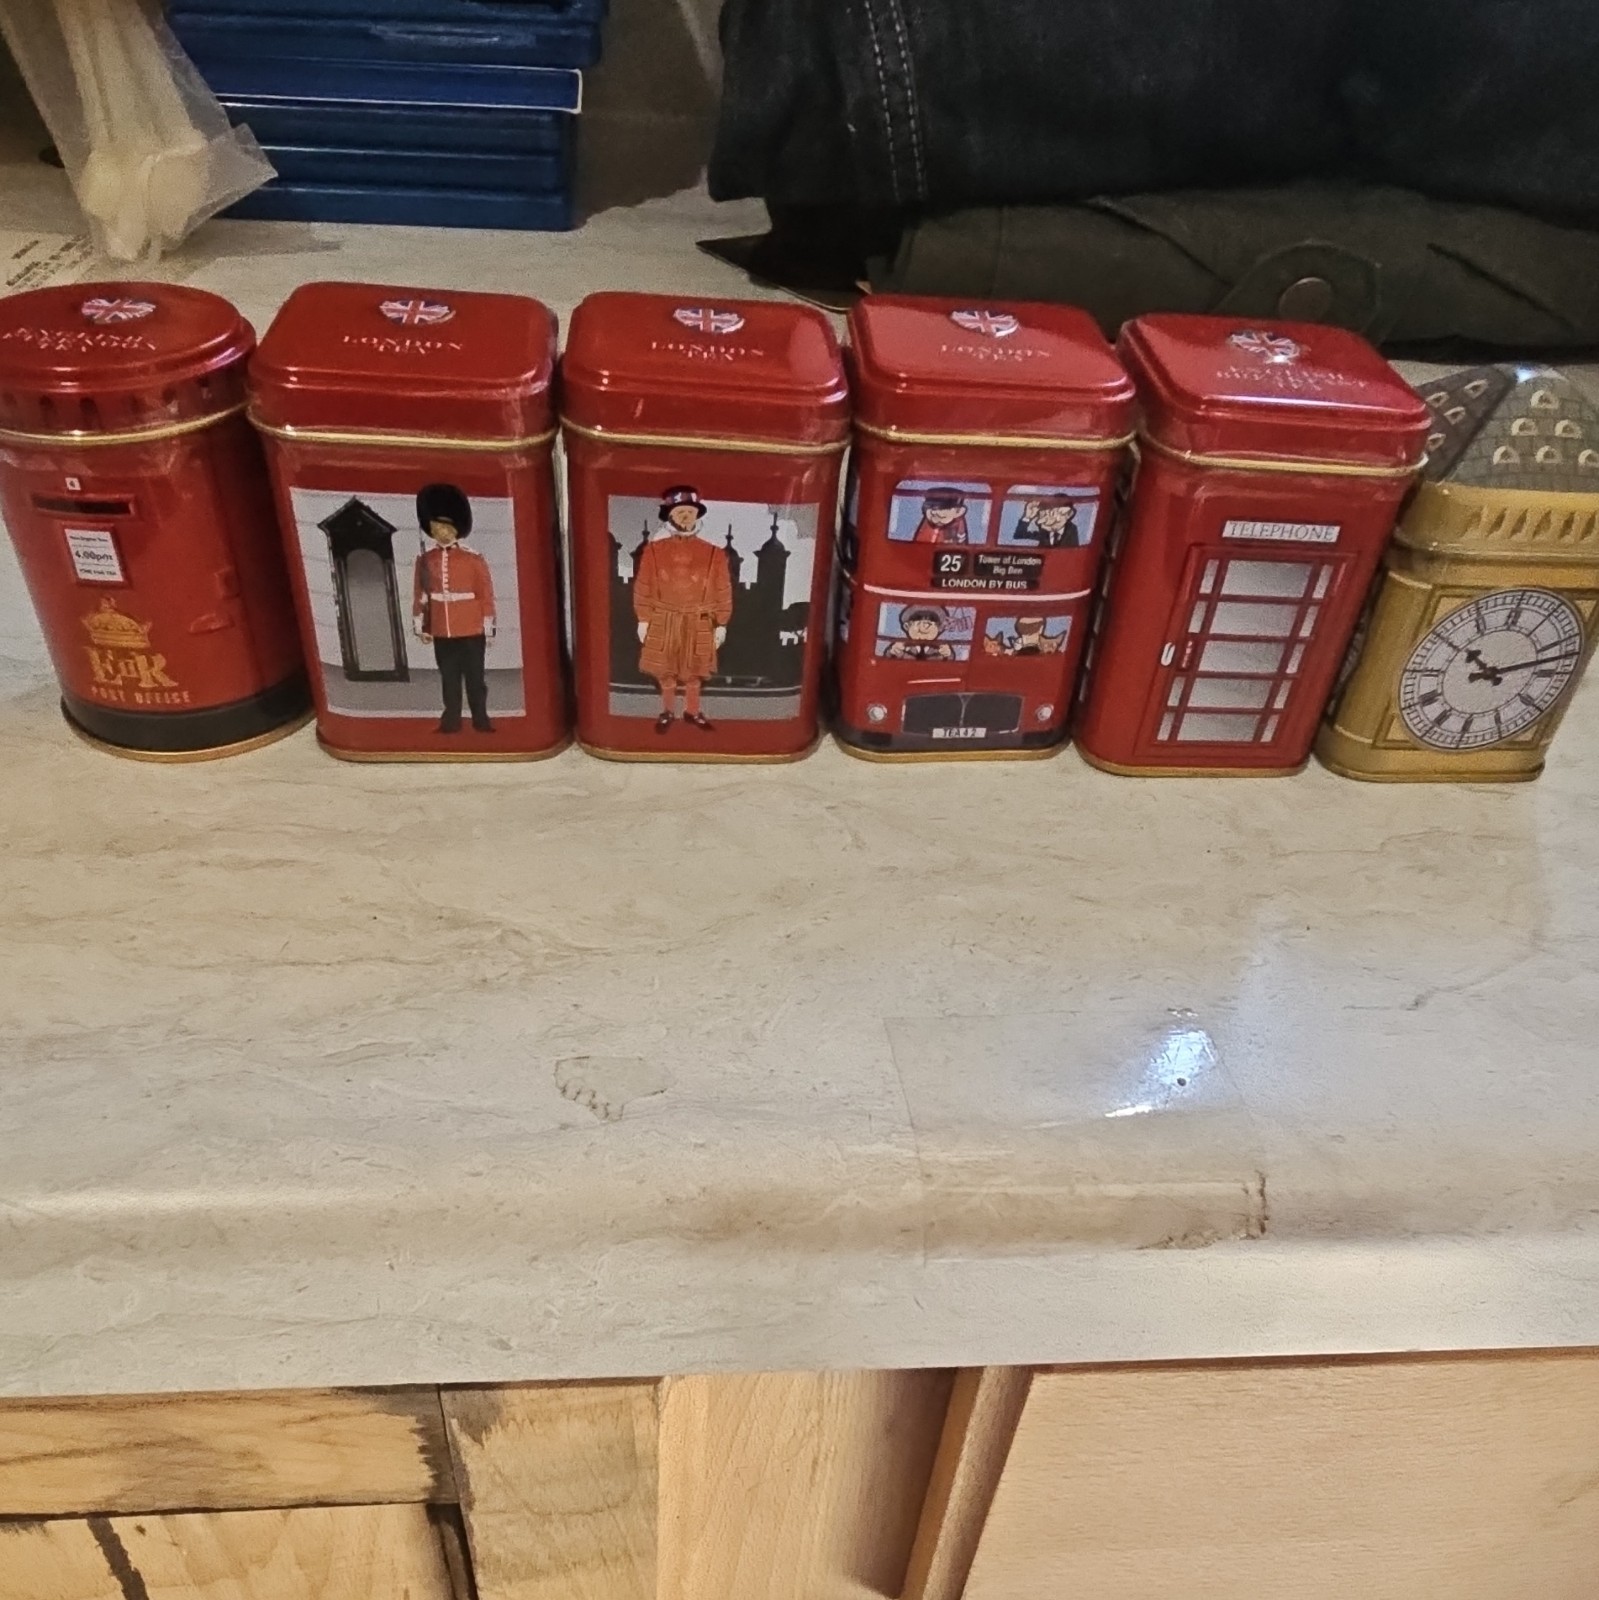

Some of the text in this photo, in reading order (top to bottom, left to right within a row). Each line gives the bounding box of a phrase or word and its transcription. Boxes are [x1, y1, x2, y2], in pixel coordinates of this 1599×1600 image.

[1229, 522, 1335, 541] TELEPHONE
[940, 554, 962, 572] 25
[978, 554, 1001, 565] Tower
[1012, 556, 1042, 566] London
[992, 566, 1023, 576] Big Ben
[941, 578, 1028, 590] LONDON BY BUS
[91, 686, 191, 705] POST OFFICE
